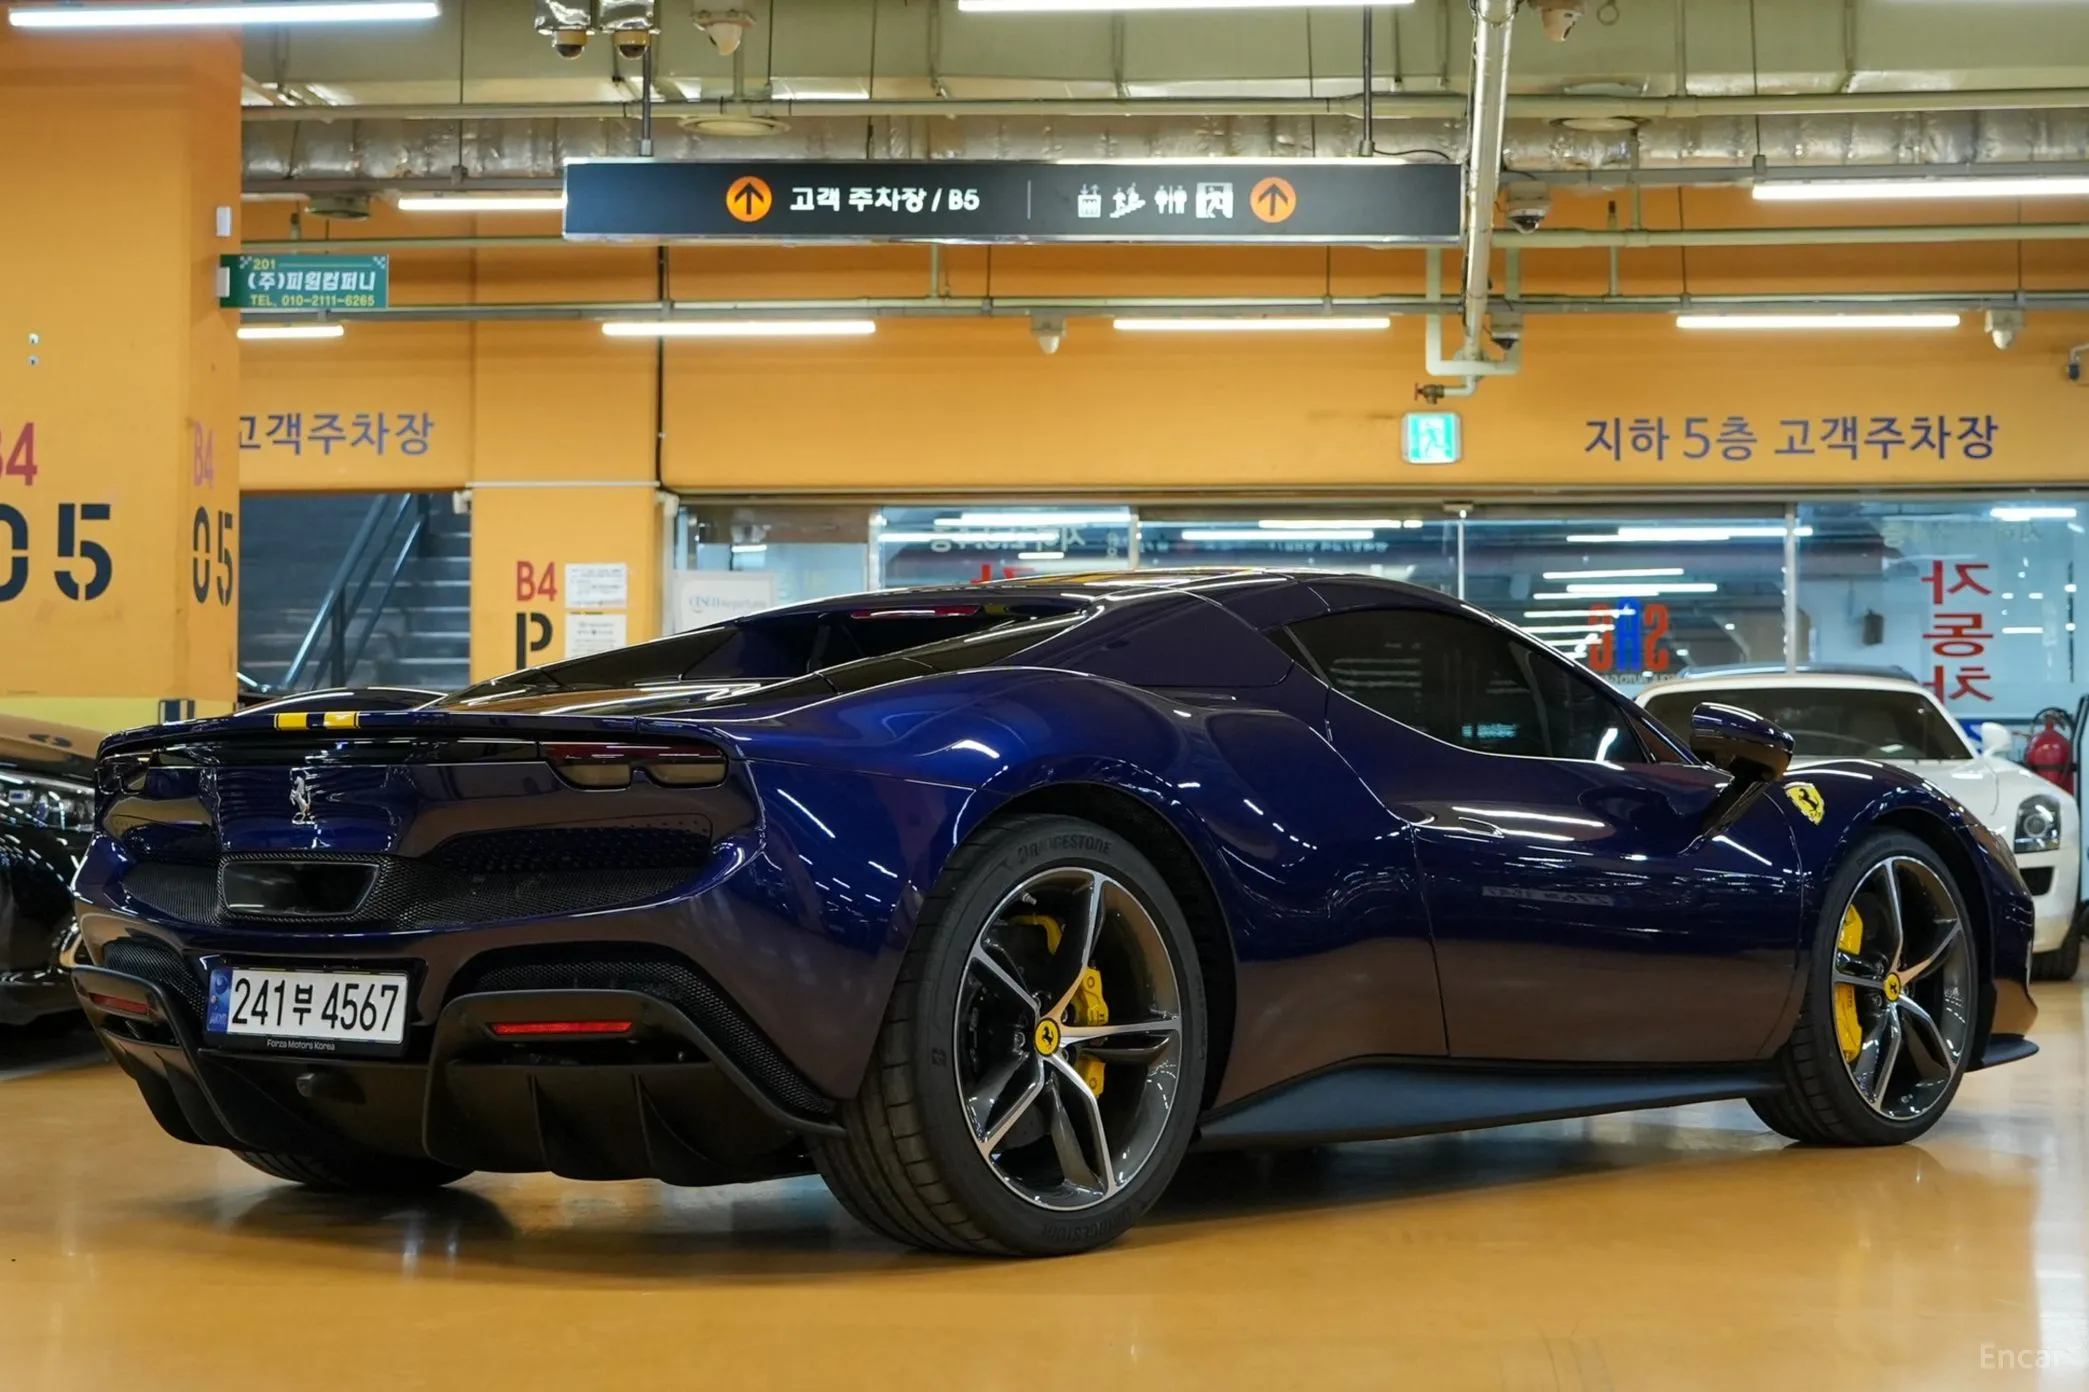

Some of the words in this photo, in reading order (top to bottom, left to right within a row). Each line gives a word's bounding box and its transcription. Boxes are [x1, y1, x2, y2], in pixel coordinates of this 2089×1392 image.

[790, 187, 840, 212] 고객
[848, 186, 927, 213] 주차장
[948, 189, 980, 211] B5
[253, 258, 276, 271] 201
[0, 422, 38, 486] 4
[192, 421, 214, 489] B4
[239, 412, 434, 456] 고객주차장
[1584, 416, 1670, 461] 지하
[1682, 416, 1758, 461] 5층
[1774, 415, 1998, 461] 고객주차장
[193, 506, 234, 606] 05
[516, 561, 557, 602] B4
[516, 612, 553, 670] P
[1017, 834, 1113, 864] BRIGESTONE
[321, 982, 399, 1032] 4567
